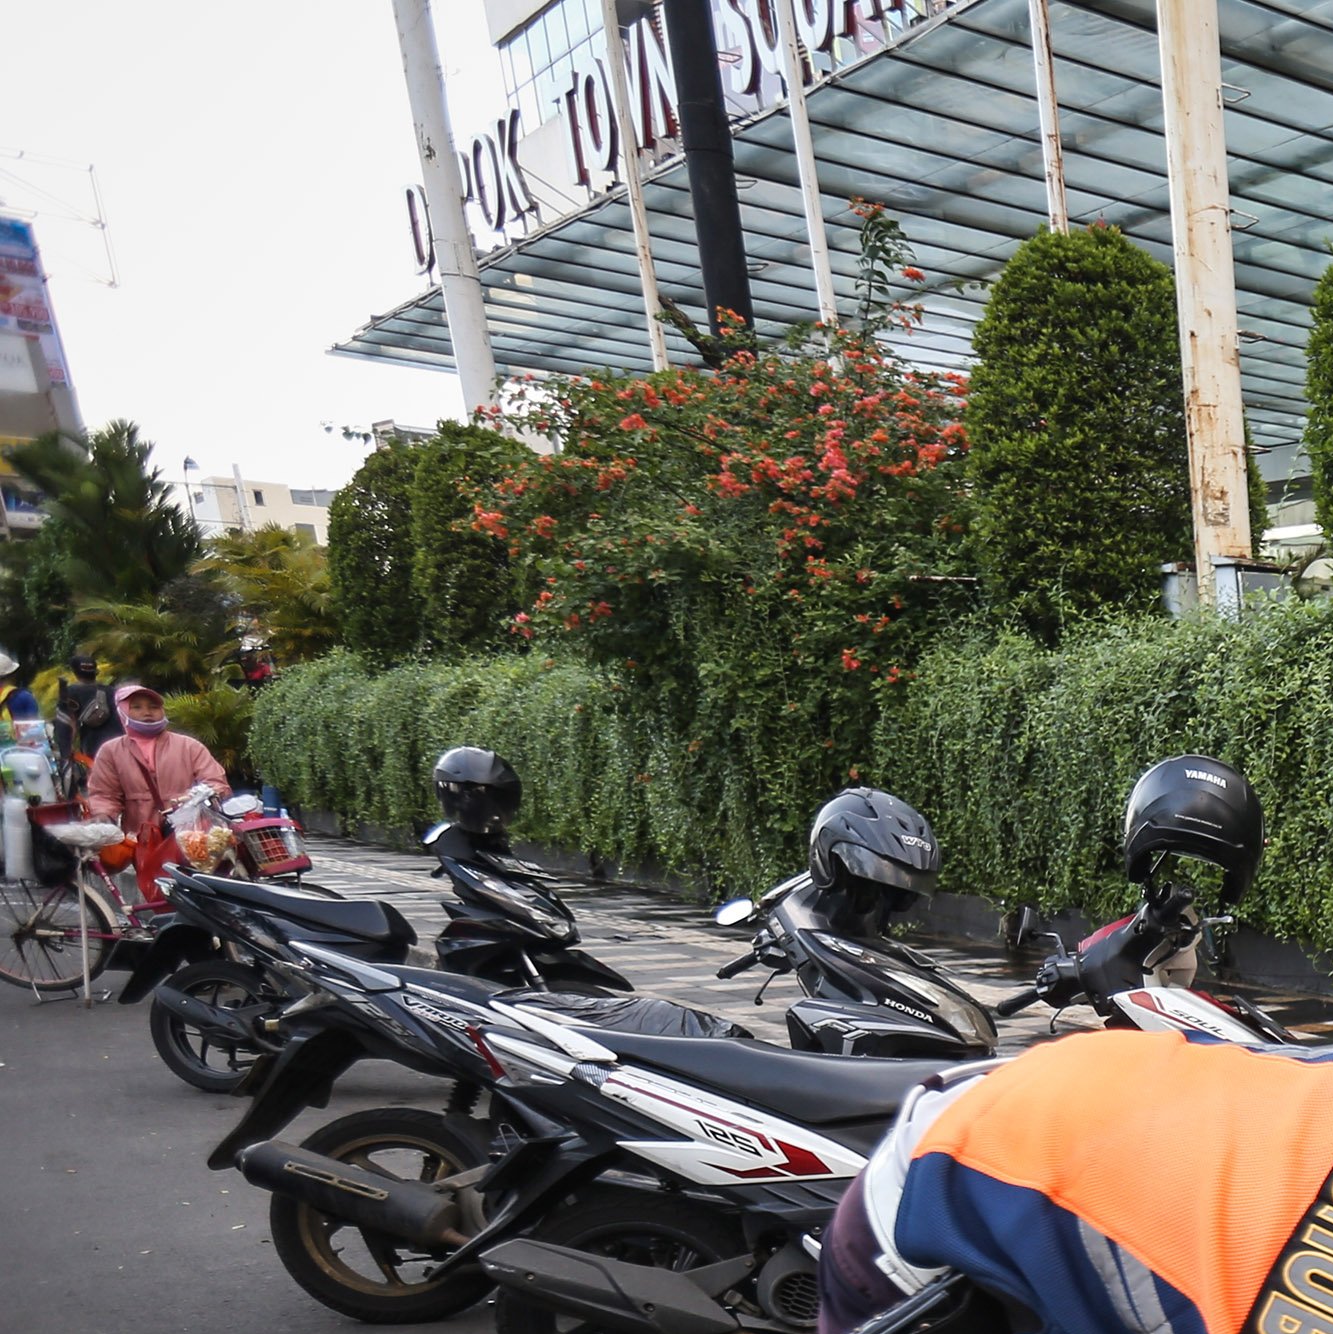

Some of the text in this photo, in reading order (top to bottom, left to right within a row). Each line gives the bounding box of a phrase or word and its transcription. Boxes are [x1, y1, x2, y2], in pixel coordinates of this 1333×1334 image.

[403, 108, 541, 275] DOK
[1185, 769, 1227, 789] YAMAHA
[884, 998, 934, 1024] HONDA
[1168, 1009, 1226, 1037] SOUL
[694, 1119, 764, 1158] 125
